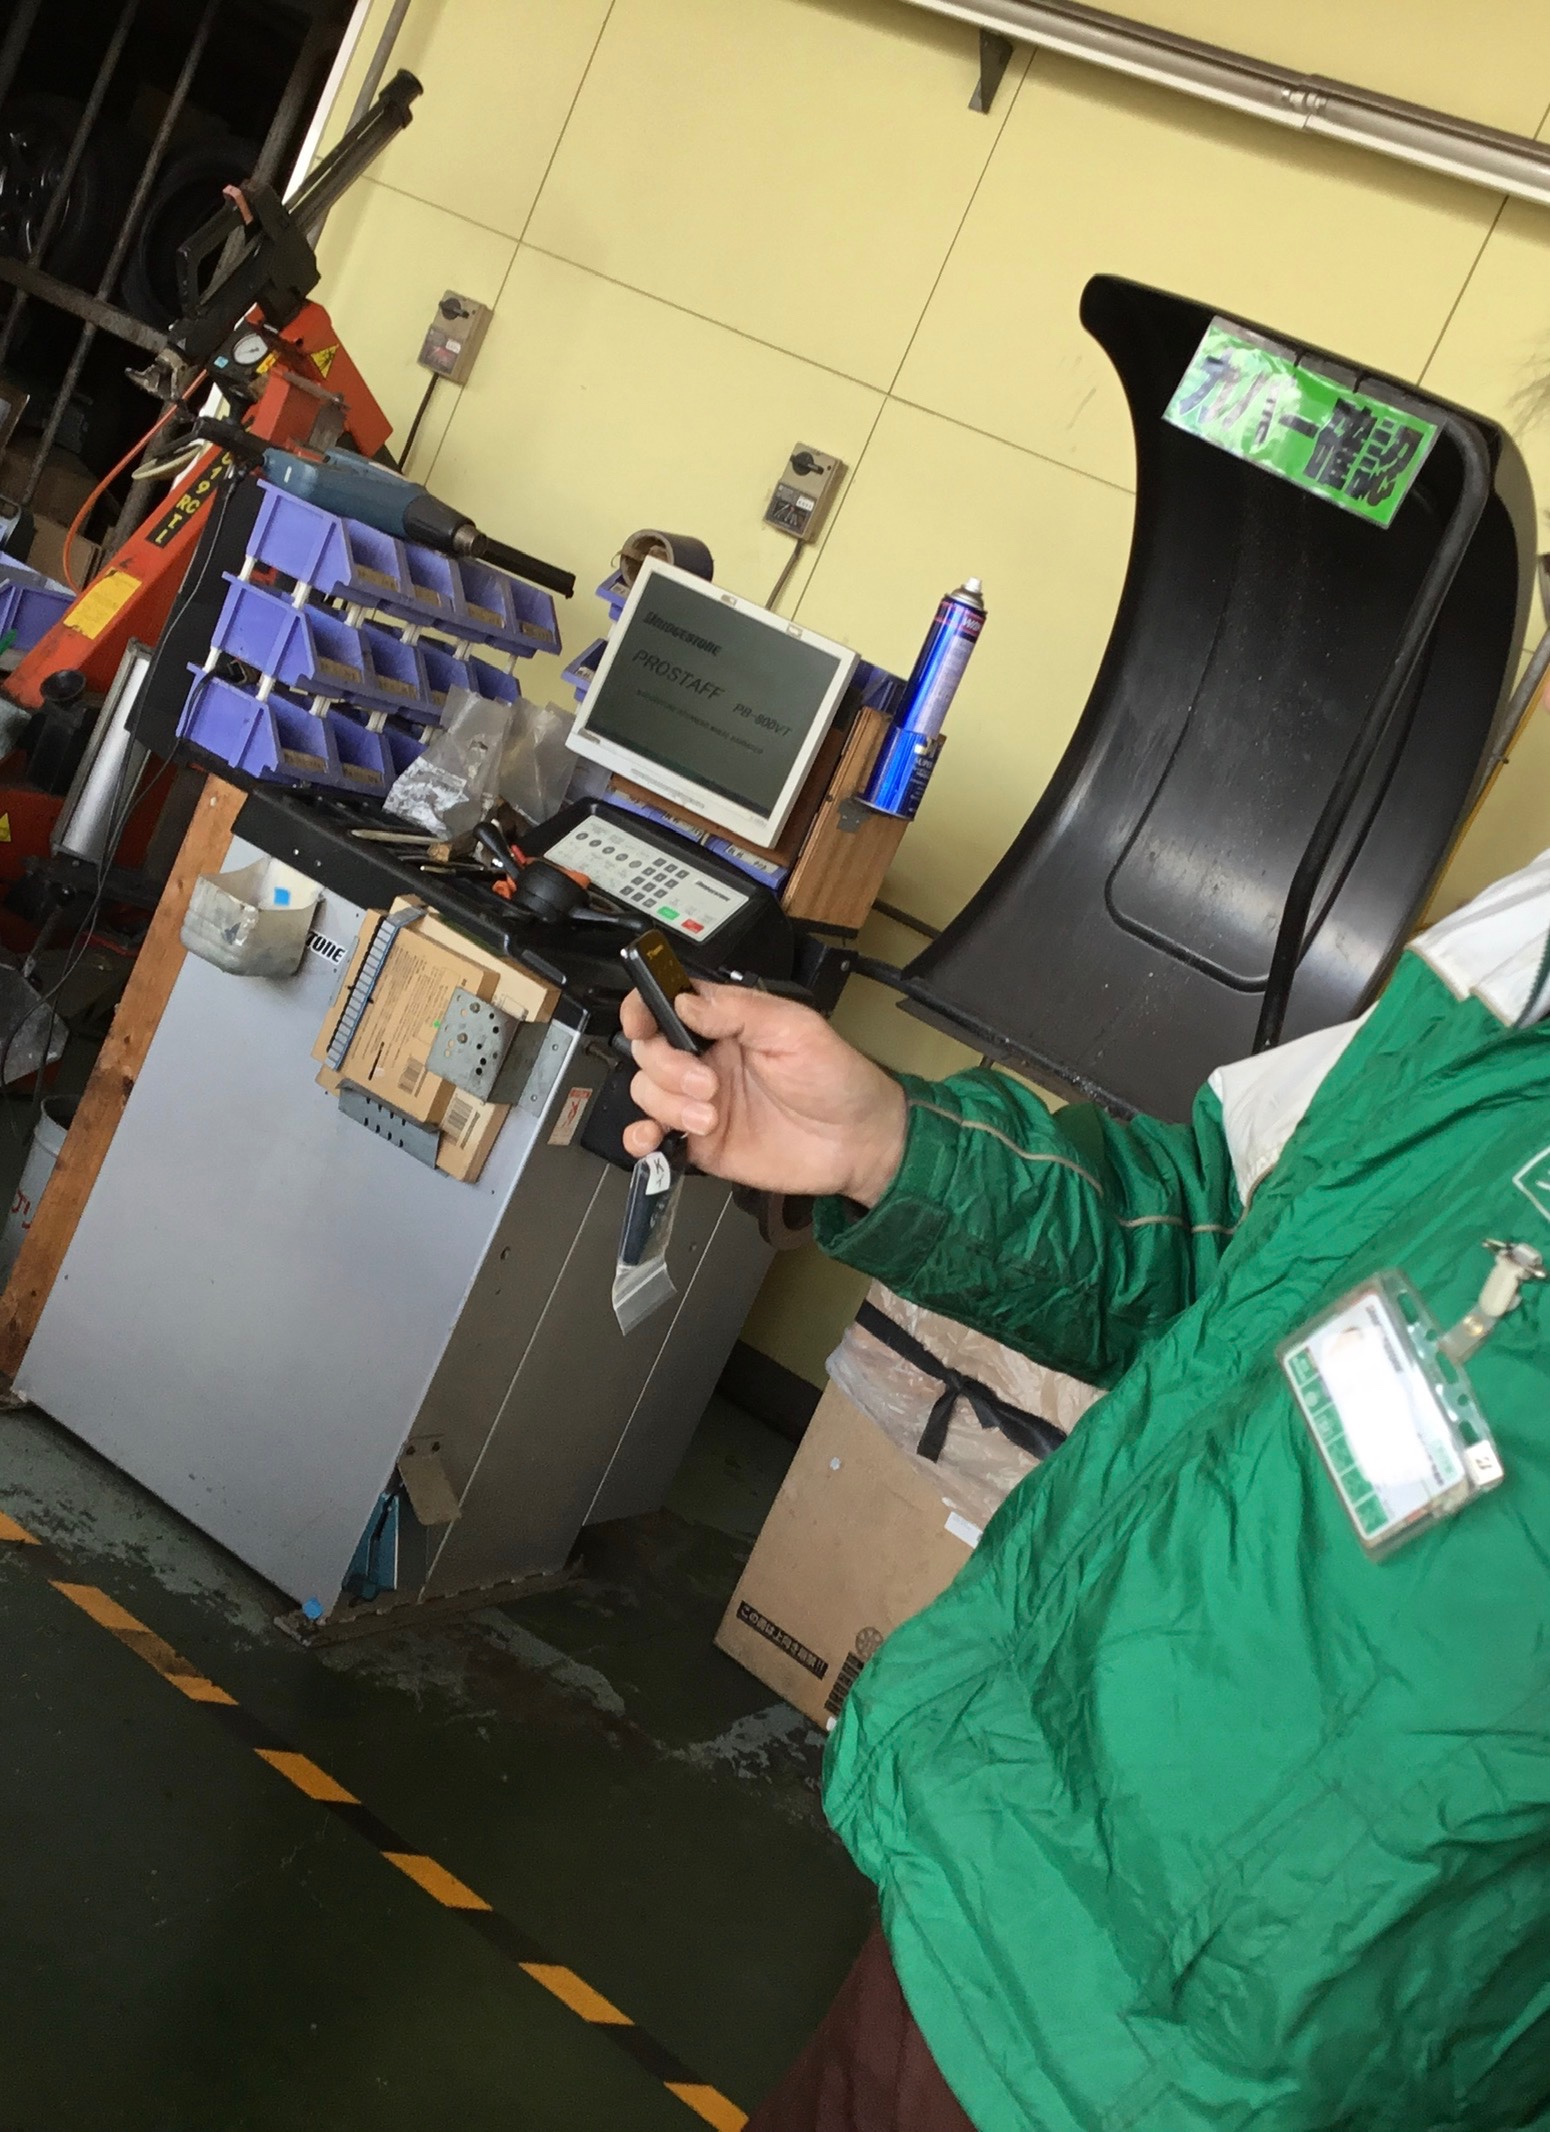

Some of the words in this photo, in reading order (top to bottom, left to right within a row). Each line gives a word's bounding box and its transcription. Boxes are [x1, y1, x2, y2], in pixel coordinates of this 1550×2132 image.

[1178, 351, 1424, 506] カバー確認
[632, 648, 726, 701] PROSTAFF
[732, 702, 793, 738] PB-800VT
